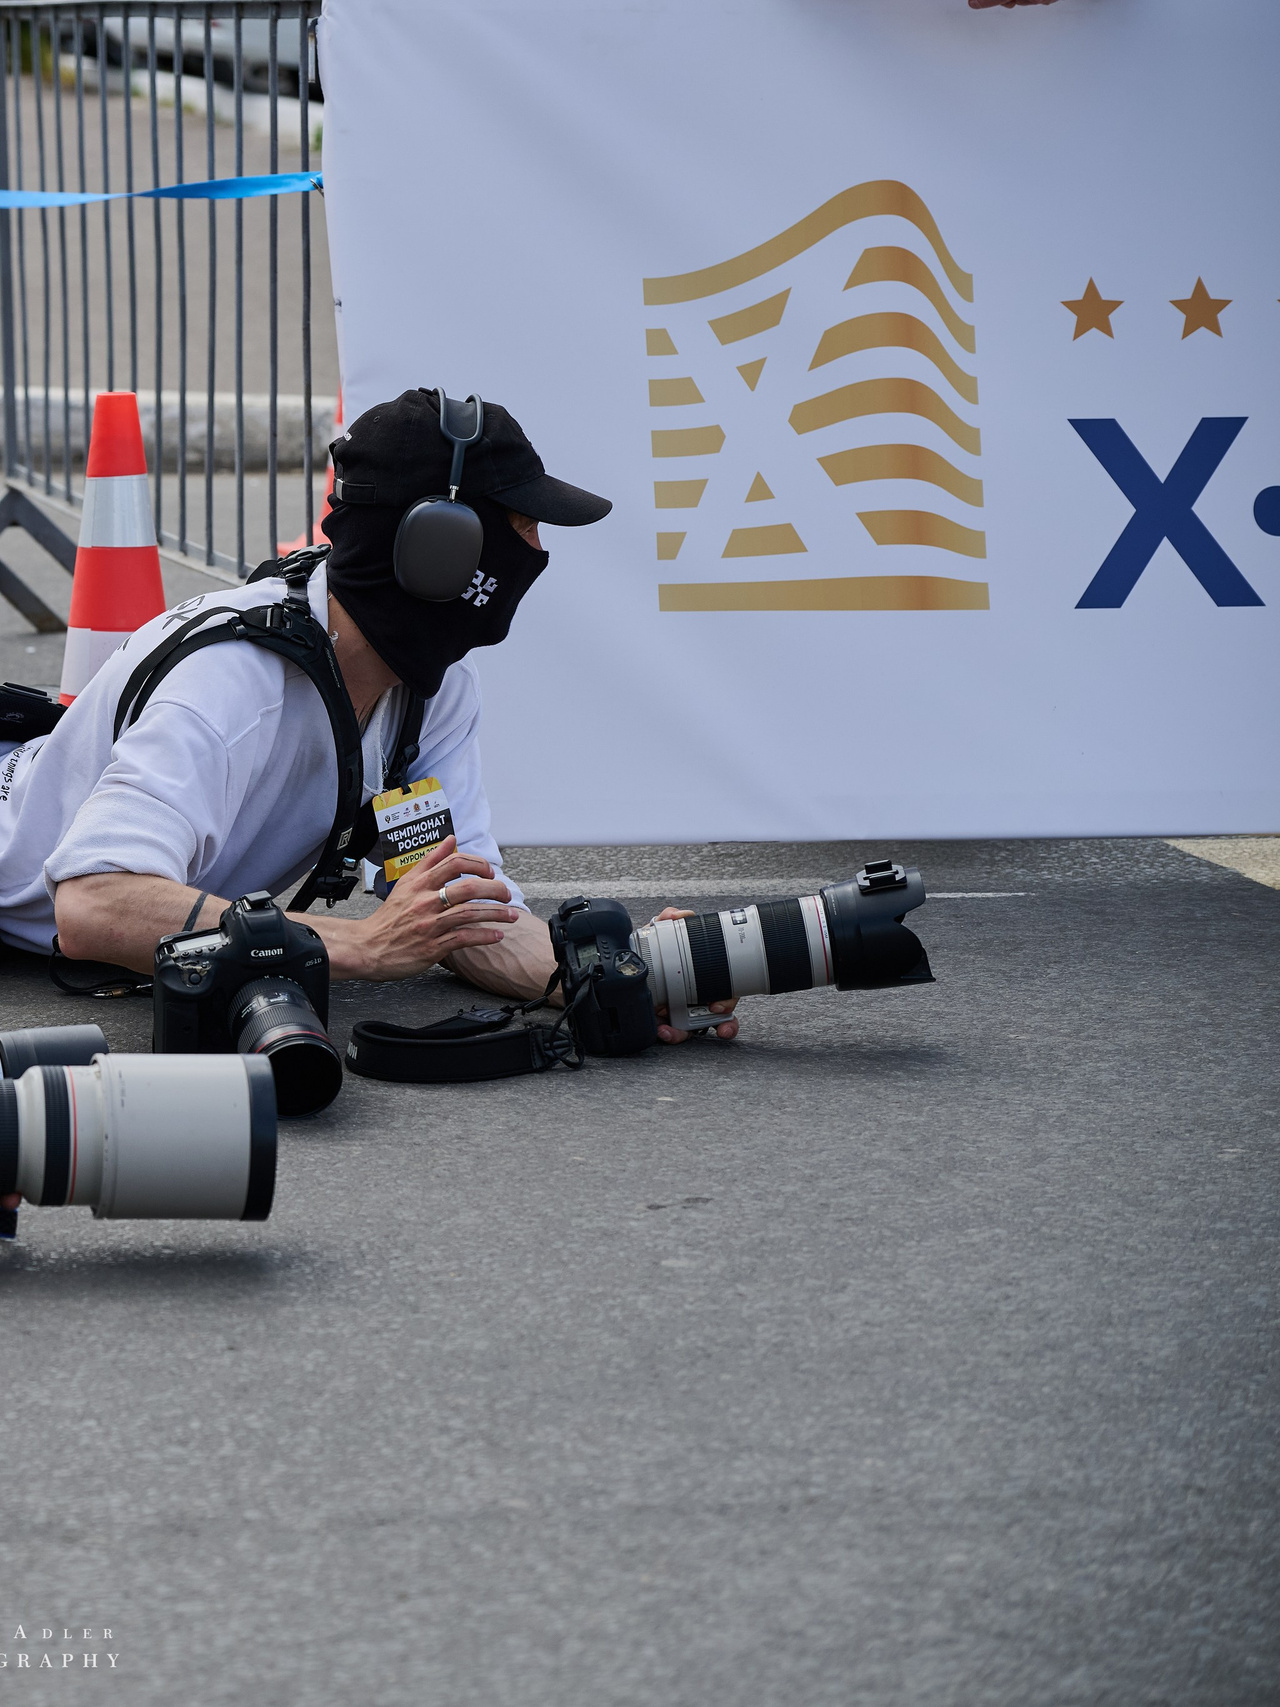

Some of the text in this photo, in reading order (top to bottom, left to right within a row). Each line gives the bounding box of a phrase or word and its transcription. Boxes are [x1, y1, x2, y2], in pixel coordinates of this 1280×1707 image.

[386, 814, 446, 843] ЧЕМПИОНАТ
[397, 828, 440, 852] РОССИИ
[399, 850, 426, 866] МУРОМ
[250, 947, 284, 958] Canon
